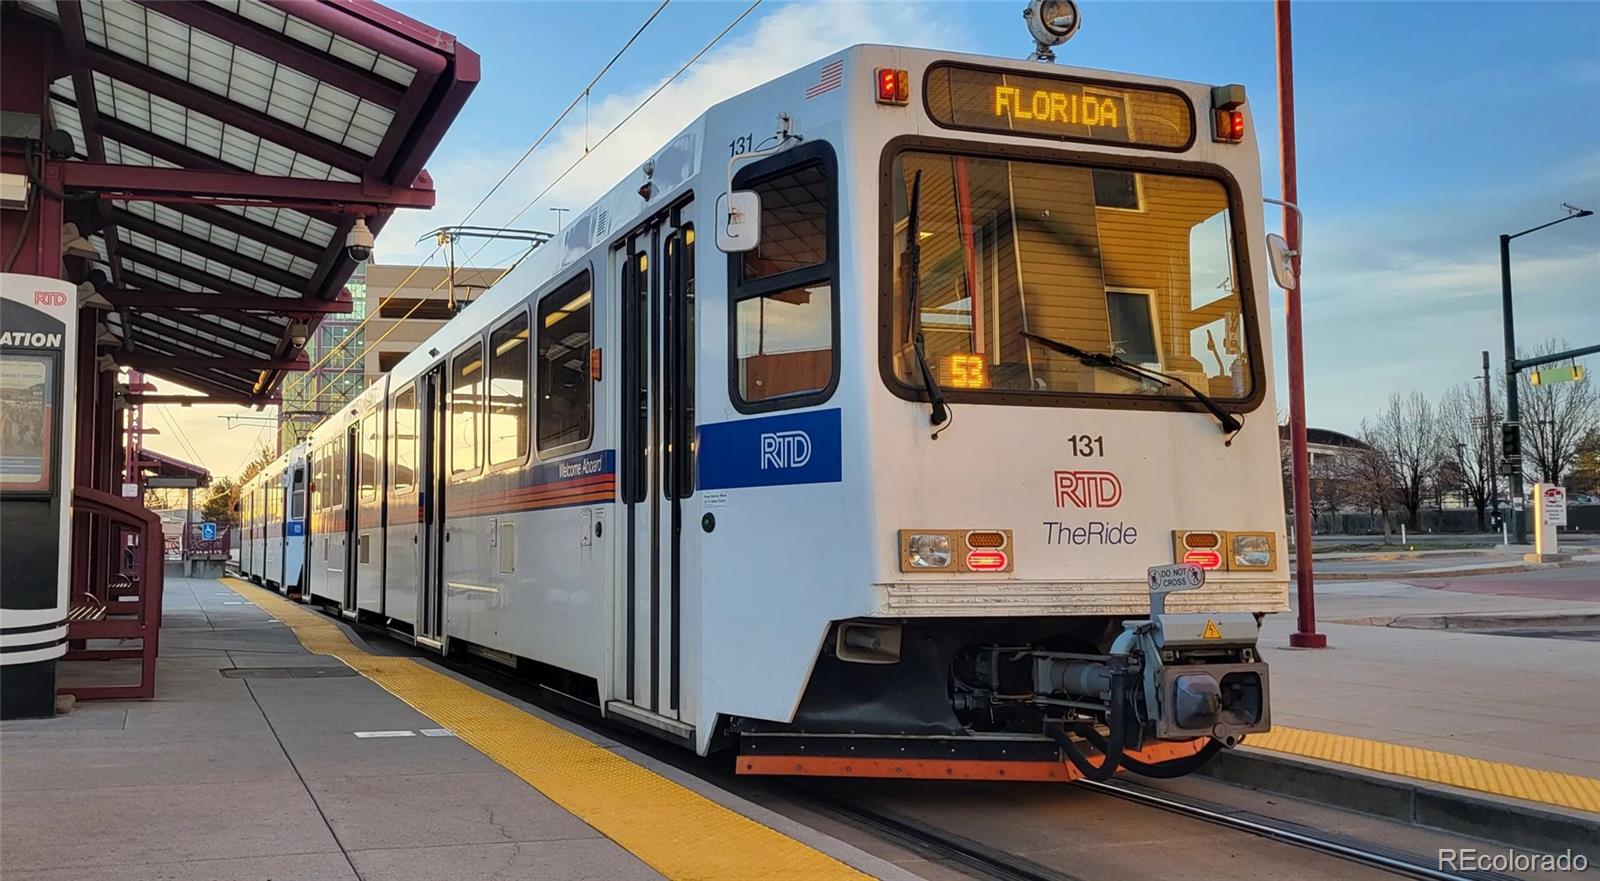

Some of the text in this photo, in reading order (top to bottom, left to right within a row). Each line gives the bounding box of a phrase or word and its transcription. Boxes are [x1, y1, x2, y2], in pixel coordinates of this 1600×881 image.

[996, 86, 1117, 128] FLORIDA
[729, 133, 752, 158] 131
[34, 291, 67, 306] RTD
[0, 331, 62, 347] ATION
[761, 430, 812, 470] RTD
[1067, 434, 1104, 457] 131
[559, 454, 602, 478] Welcome Aboard
[1054, 470, 1122, 508] RTD
[1043, 521, 1137, 545] TheRide
[1161, 568, 1186, 577] DO NOT
[1163, 577, 1187, 587] CROSS
